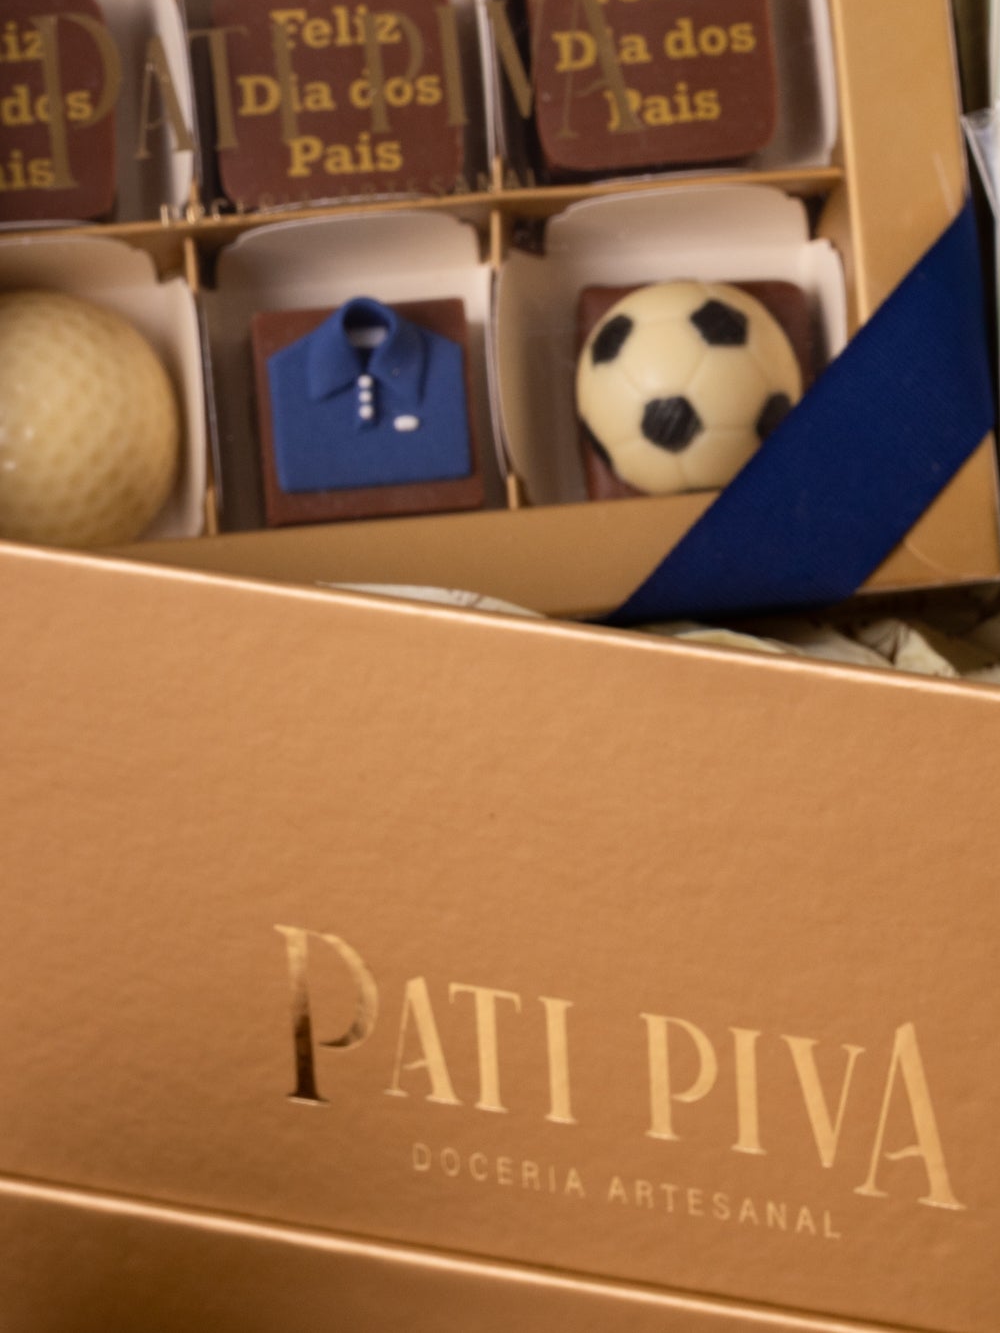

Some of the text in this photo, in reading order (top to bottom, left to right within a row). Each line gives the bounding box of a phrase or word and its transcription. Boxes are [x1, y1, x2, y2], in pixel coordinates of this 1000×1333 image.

[270, 4, 402, 52] Feliz
[553, 18, 757, 73] Dia dos
[238, 66, 443, 117] Dia dos
[605, 83, 722, 132] Pais
[288, 130, 402, 178] Pais
[273, 923, 968, 1211] PATI PIVA
[411, 1140, 843, 1240] DOCERIA ARTESANAL
